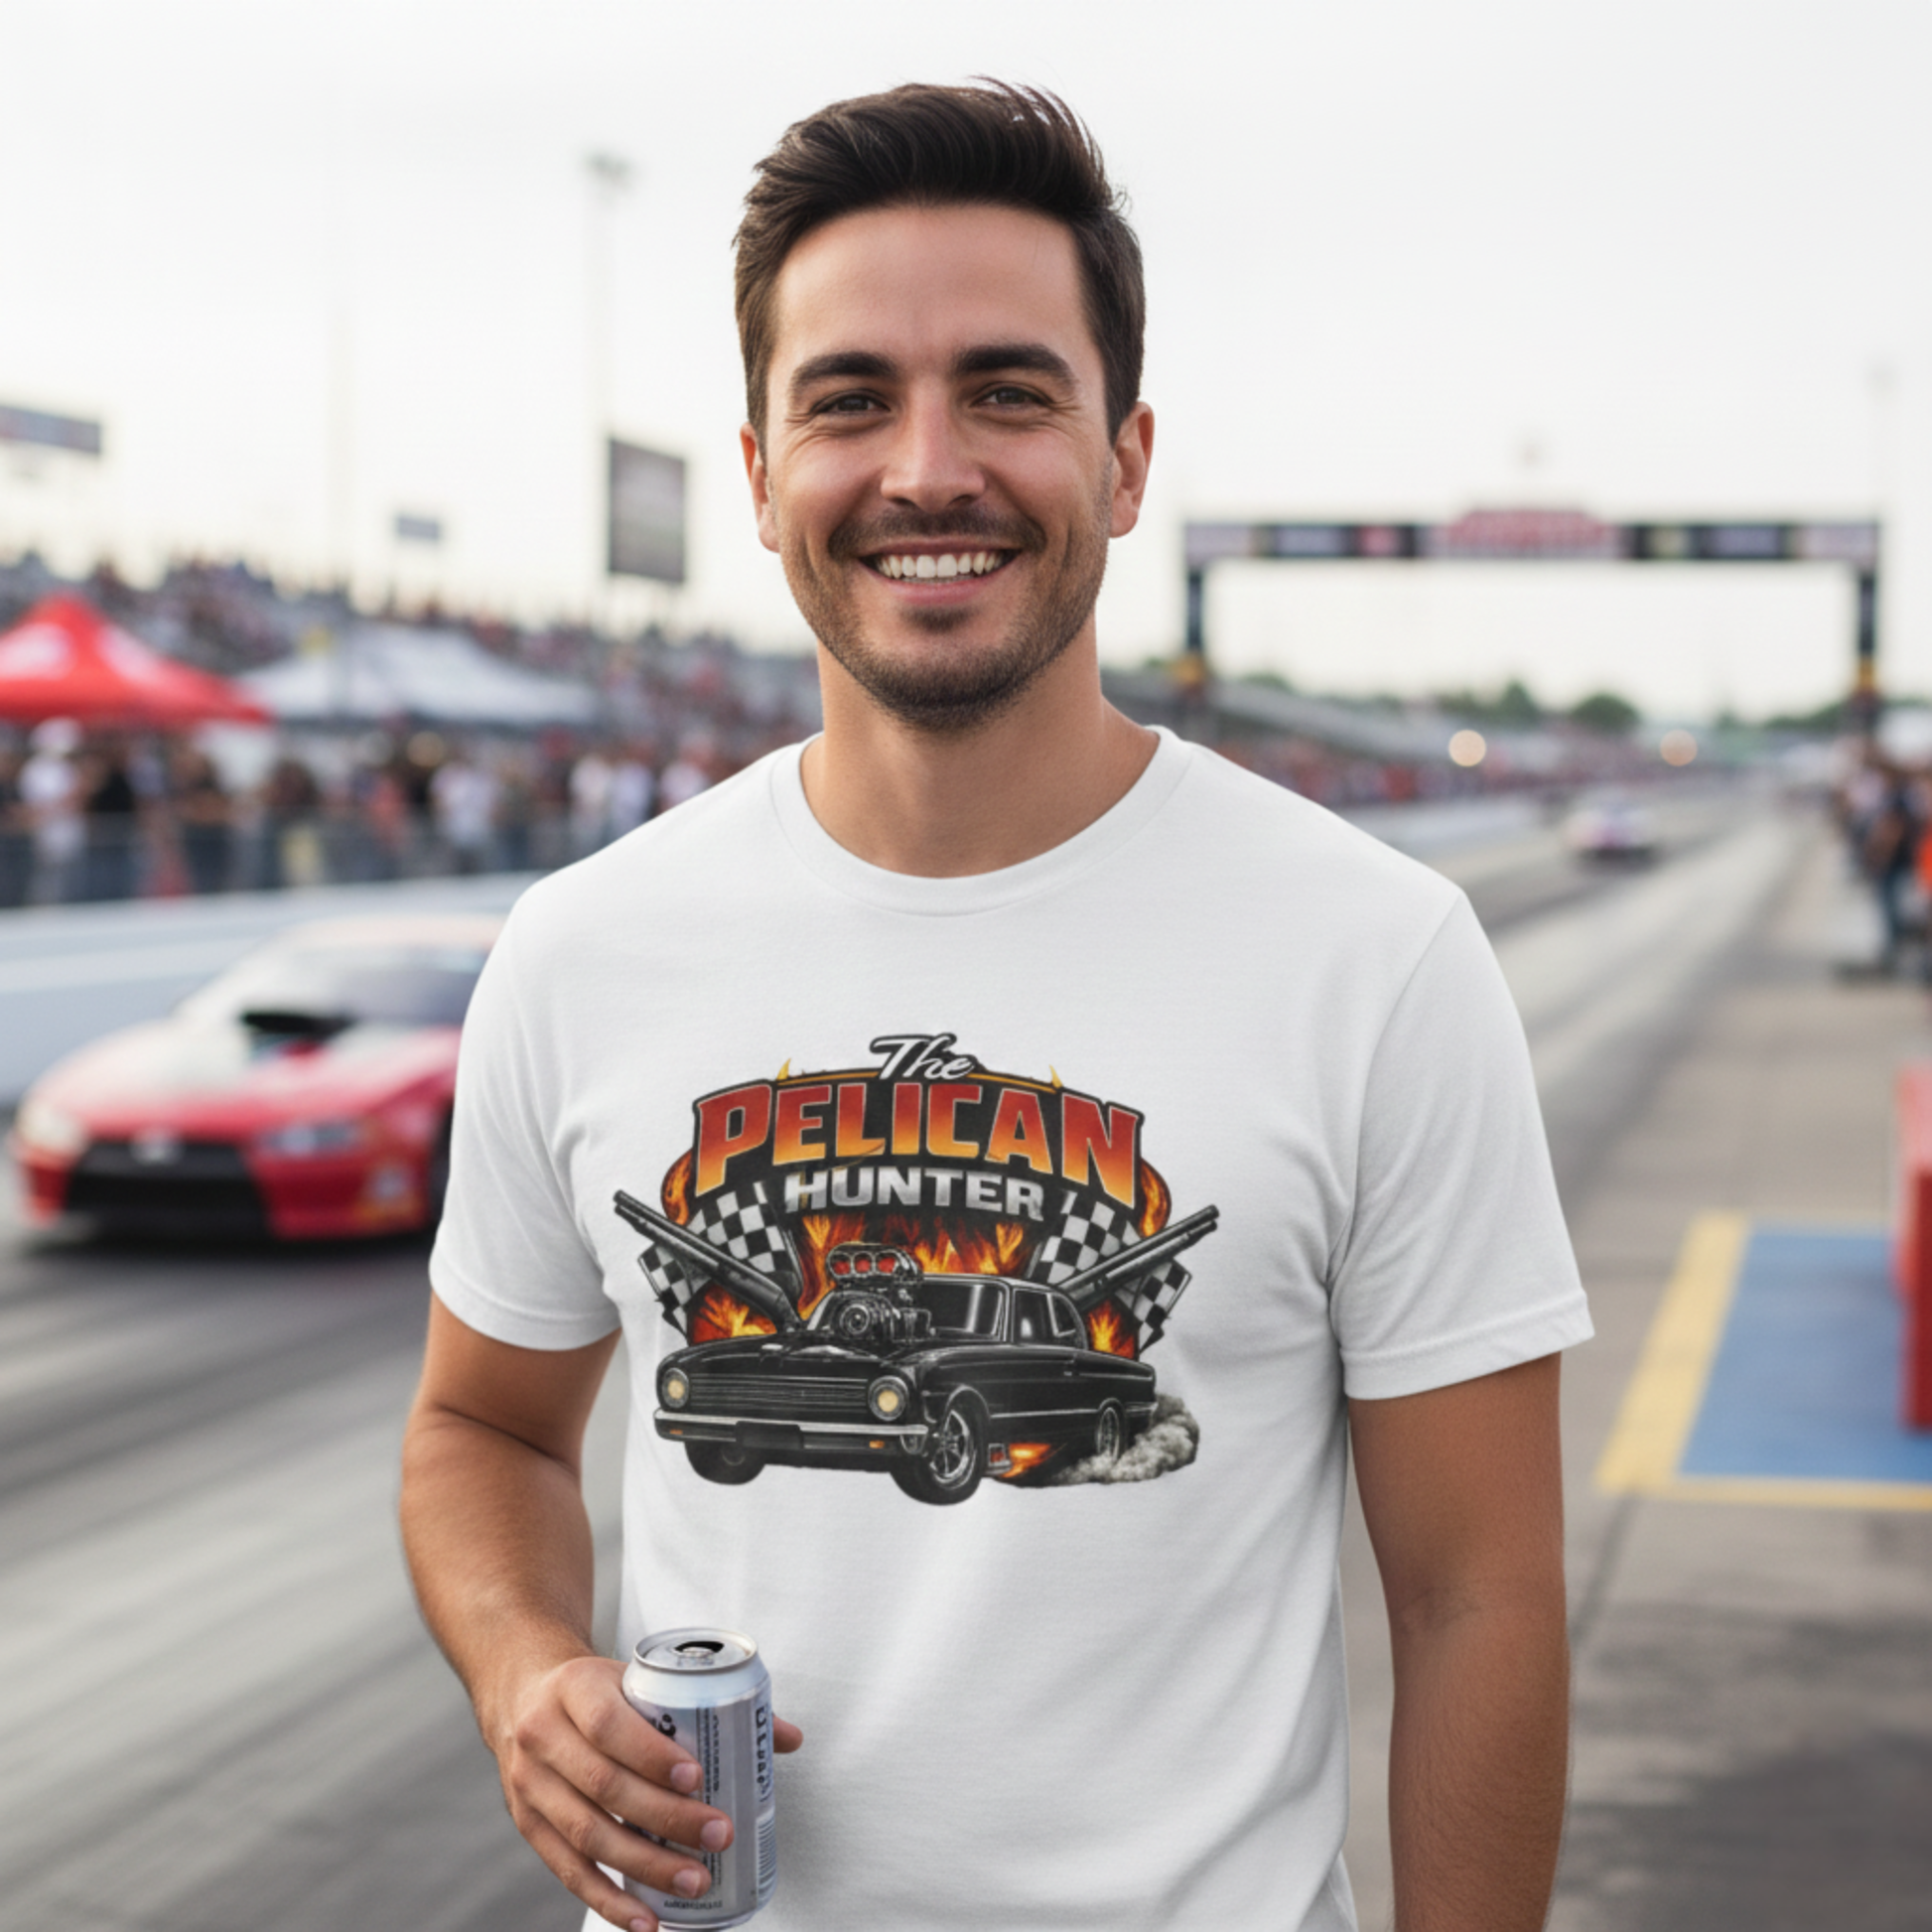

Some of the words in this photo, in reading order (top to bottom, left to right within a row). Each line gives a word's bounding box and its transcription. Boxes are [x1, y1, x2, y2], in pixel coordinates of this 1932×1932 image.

[872, 1034, 976, 1080] The
[695, 1083, 1138, 1209] PELICAN
[784, 1167, 1044, 1221] HUNTER
